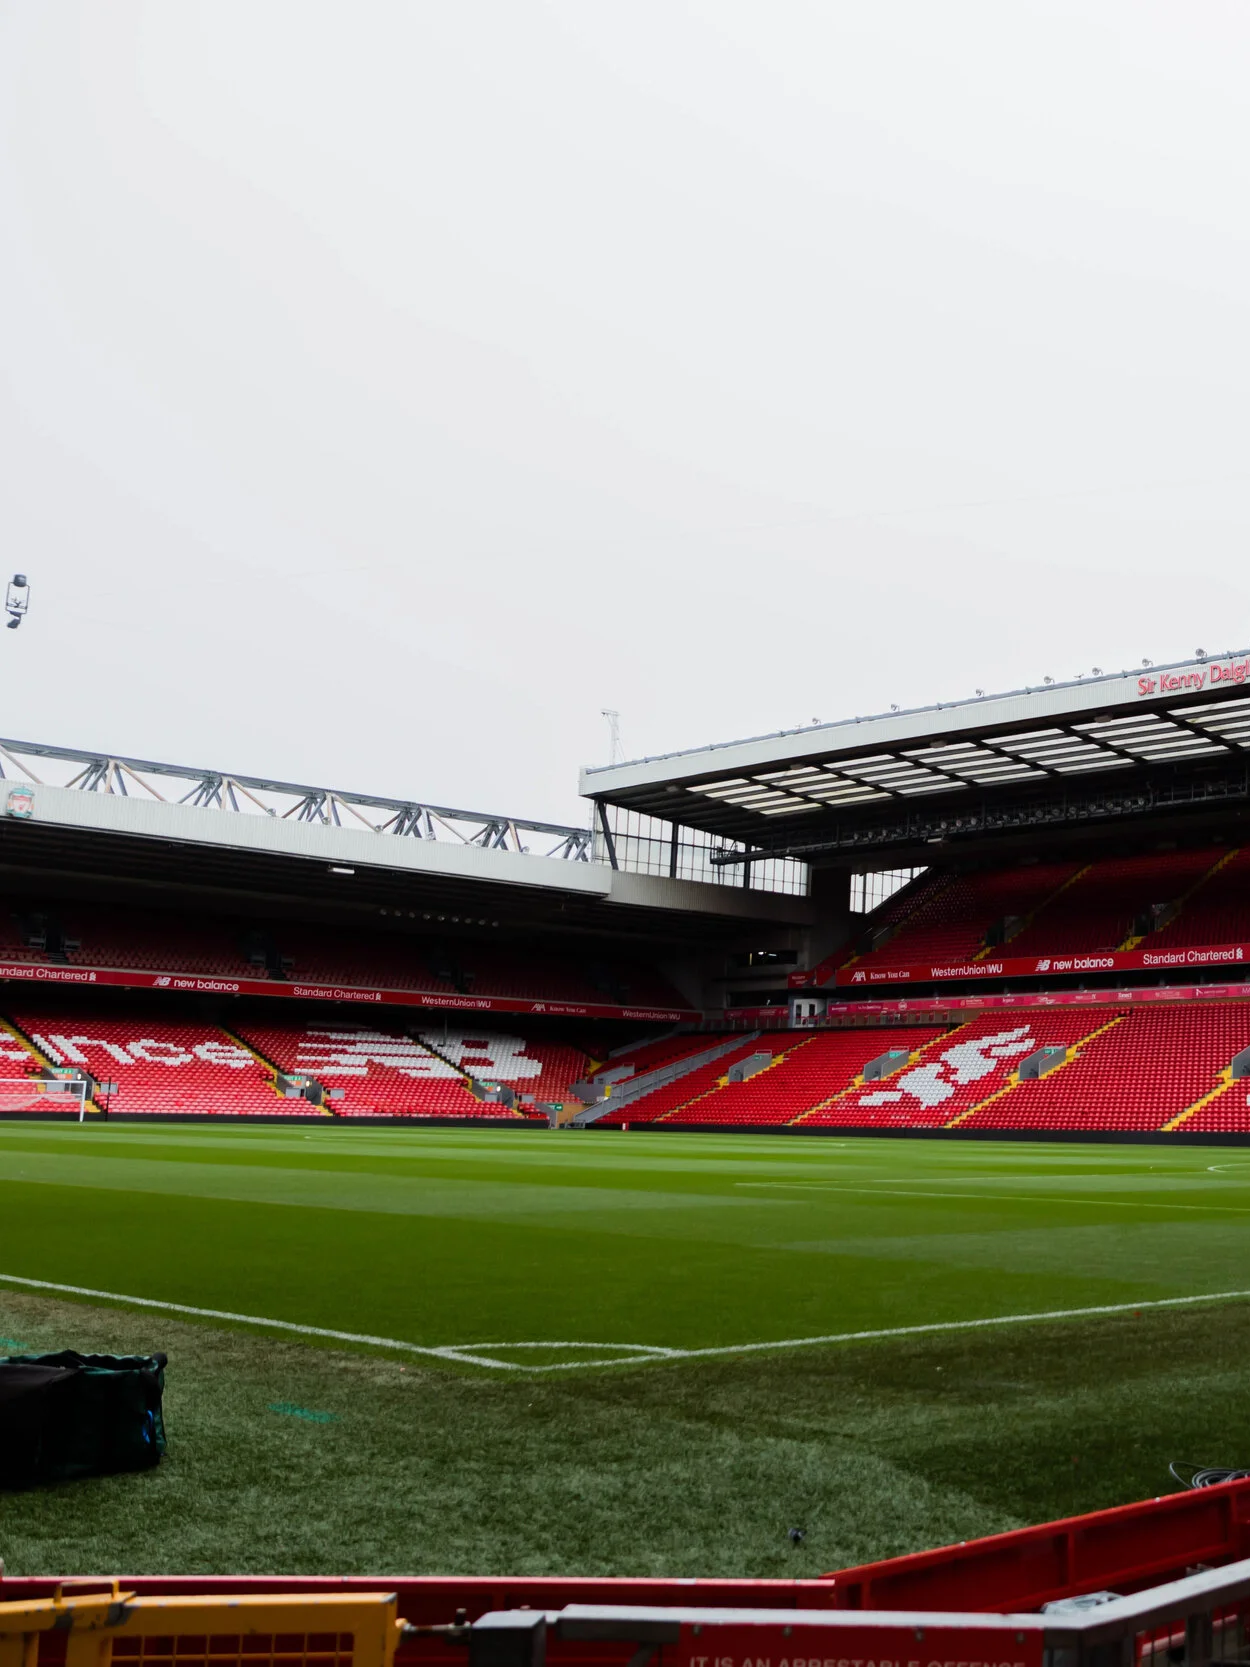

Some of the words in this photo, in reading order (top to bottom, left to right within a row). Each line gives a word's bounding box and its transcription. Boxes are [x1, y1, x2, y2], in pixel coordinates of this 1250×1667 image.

[1138, 677, 1156, 696] Sir
[1160, 670, 1206, 691] Kenny
[1053, 960, 1072, 970] new
[1074, 957, 1114, 969] balance
[1143, 951, 1185, 965] Standard
[1187, 949, 1235, 963] Chartered
[36, 968, 88, 981] Chartered
[851, 971, 866, 982] AXA
[870, 972, 886, 980] Know
[887, 971, 898, 979] You
[898, 970, 910, 978] Can
[931, 963, 986, 977] WesternUnion
[174, 979, 194, 989] new
[197, 979, 239, 991] balance
[293, 986, 332, 998] Standard
[334, 989, 375, 1001] Chartered
[690, 1656, 708, 1667] IT
[714, 1656, 734, 1667] IS
[742, 1657, 770, 1667] AN
